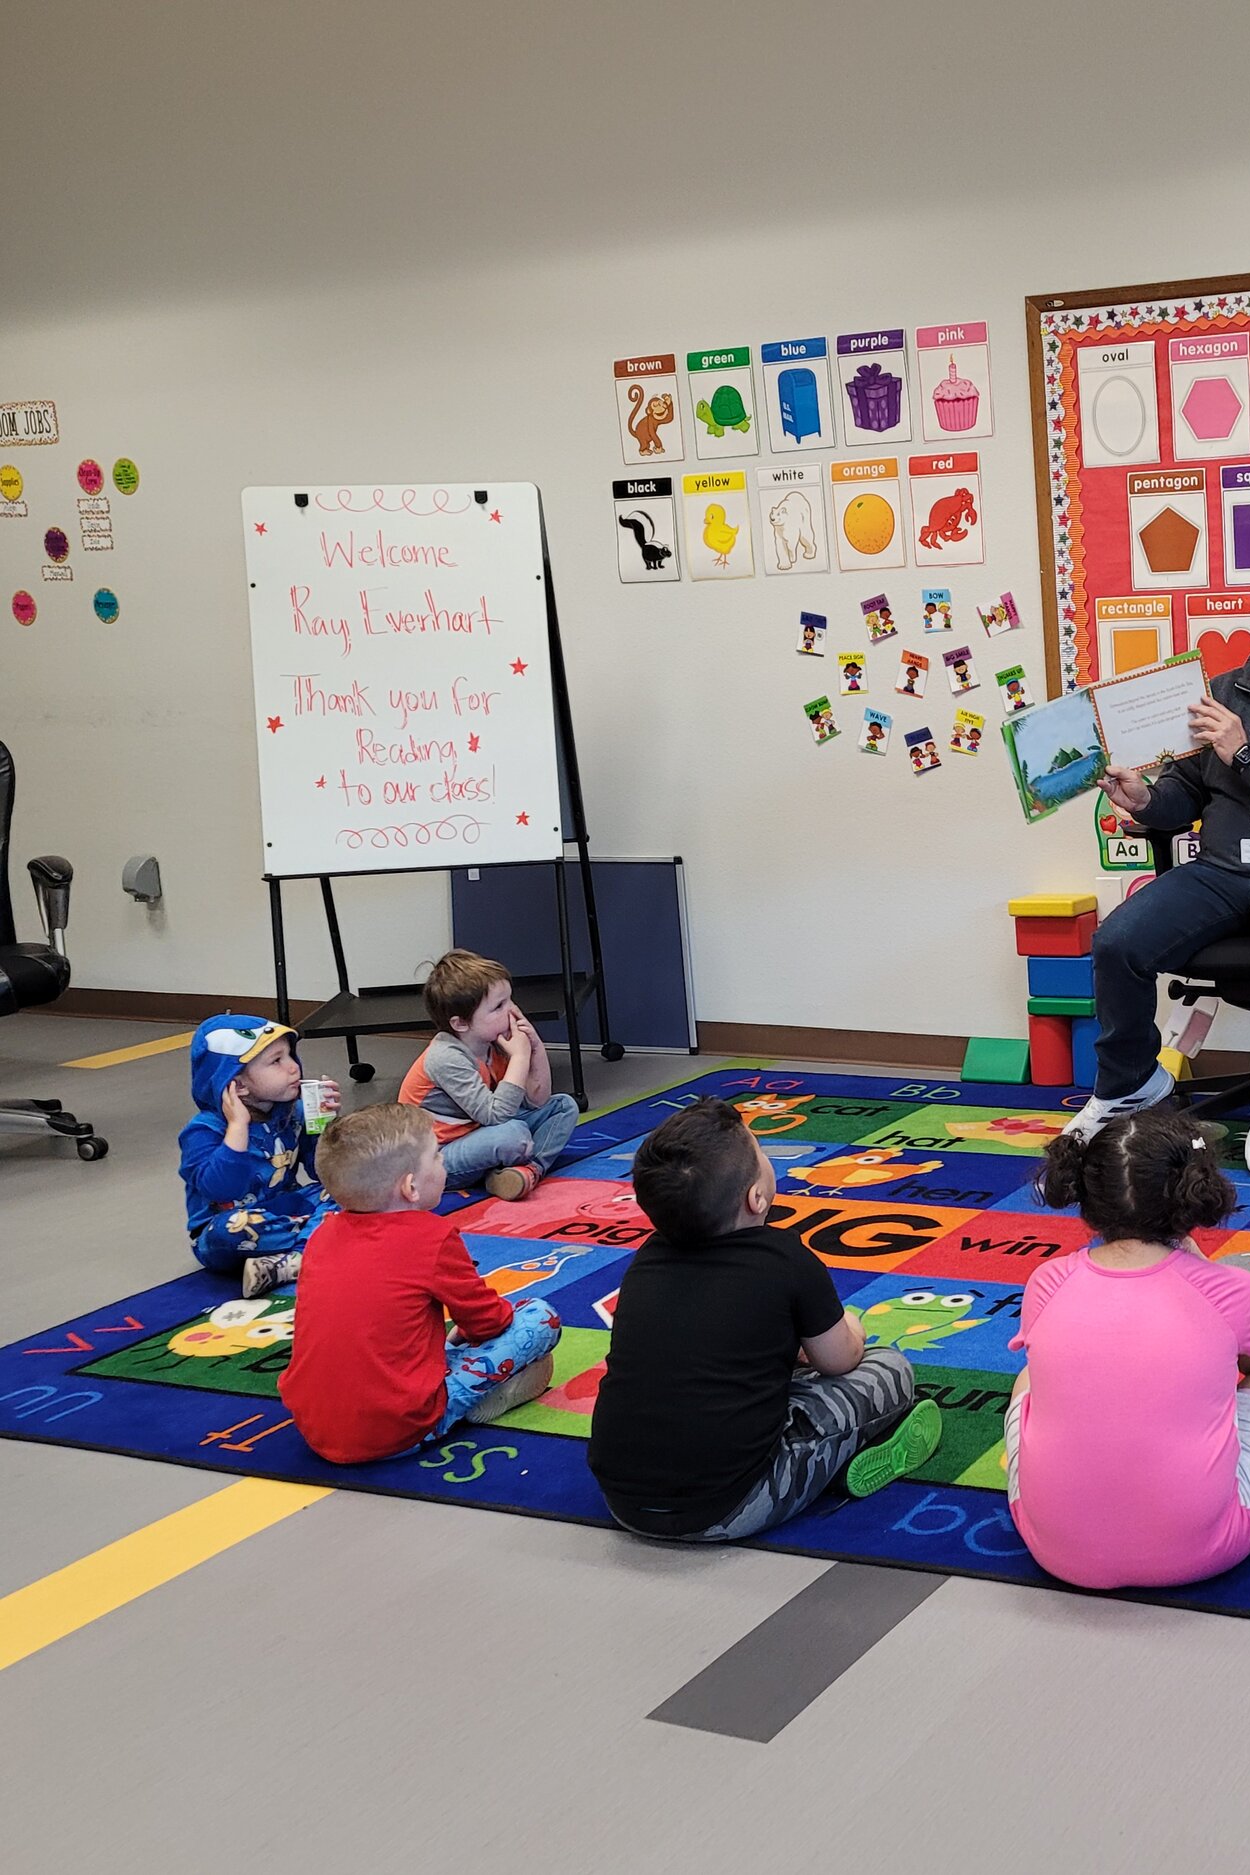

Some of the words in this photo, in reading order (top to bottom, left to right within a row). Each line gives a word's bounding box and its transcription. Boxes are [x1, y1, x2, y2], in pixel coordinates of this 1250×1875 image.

[849, 334, 889, 350] purple
[937, 327, 964, 343] pink
[781, 342, 806, 356] blue
[1102, 349, 1129, 363] oval
[1179, 341, 1238, 358] hexagon
[626, 358, 663, 372] brown
[701, 352, 735, 368] green
[24, 409, 51, 435] JOBS
[843, 464, 886, 478] orange
[932, 457, 954, 471] red
[694, 475, 730, 490] yellow
[772, 468, 804, 482] white
[627, 481, 656, 494] black
[1134, 475, 1198, 492] pentagon
[320, 530, 458, 568] Welcome
[1102, 601, 1164, 618] rectangle
[1207, 598, 1242, 611] heart
[291, 585, 351, 659] Ray
[360, 587, 504, 634] Everhart
[280, 674, 376, 716] Thank
[389, 689, 438, 729] you
[452, 676, 501, 716] for
[869, 712, 887, 722] WAVE
[357, 728, 458, 777] Reading
[337, 769, 372, 806] to
[384, 781, 420, 804] our
[429, 764, 495, 804] class!
[1115, 842, 1139, 857] Aa
[810, 1099, 890, 1121] cat
[873, 1129, 966, 1149] hat
[888, 1179, 994, 1204] hen
[547, 1217, 648, 1246] pig
[960, 1234, 1061, 1259] win
